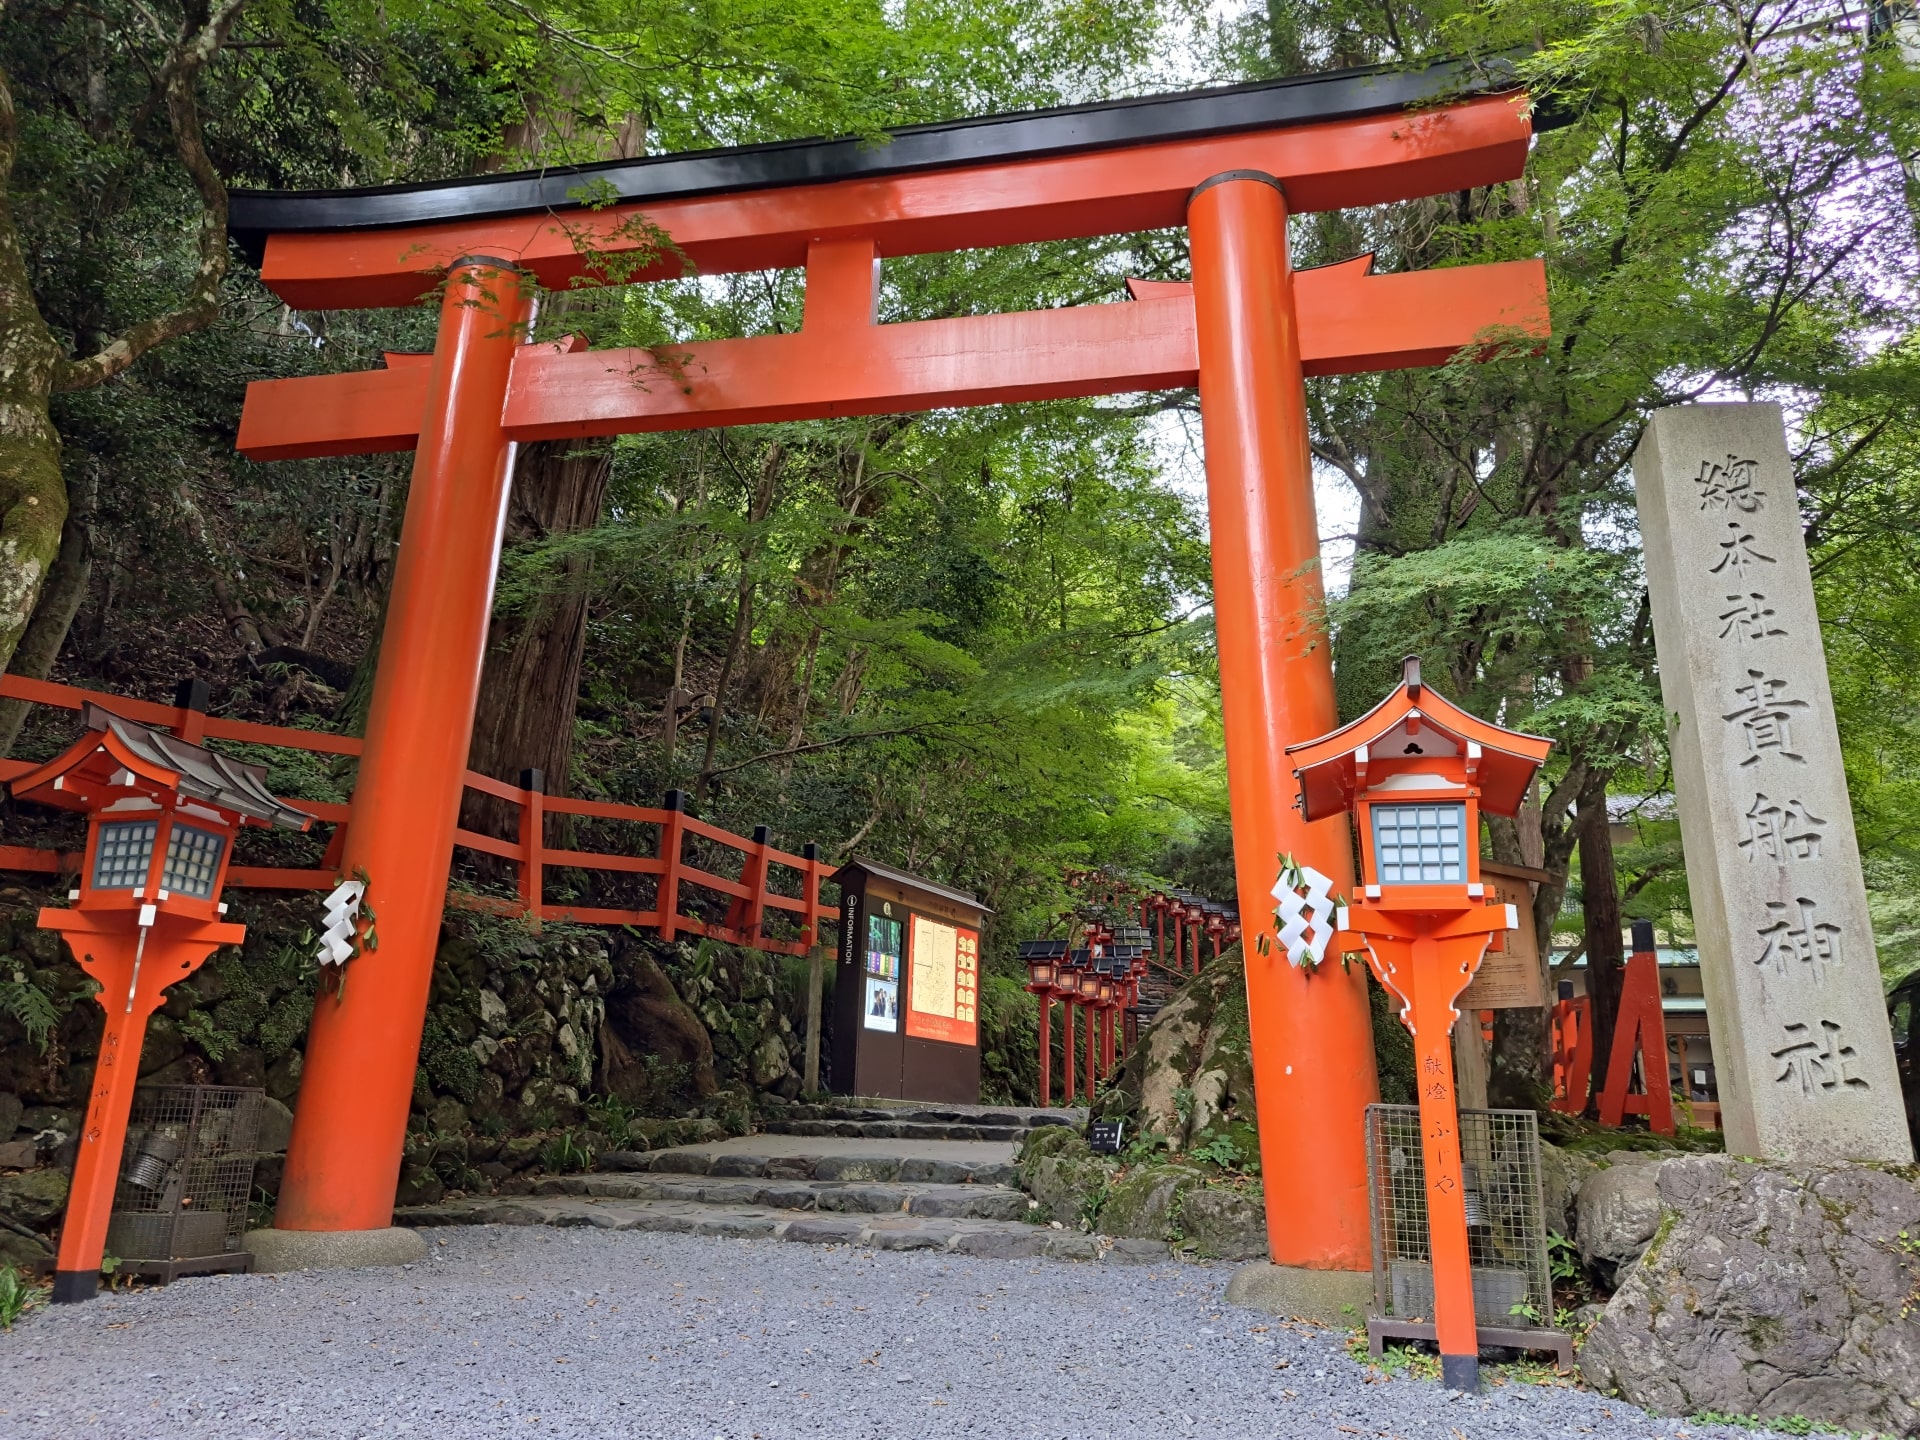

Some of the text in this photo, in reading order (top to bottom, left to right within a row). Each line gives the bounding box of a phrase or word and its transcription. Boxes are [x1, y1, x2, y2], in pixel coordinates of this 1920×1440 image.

[845, 907, 855, 965] INFORMATION
[1430, 1121, 1455, 1194] ふじや
